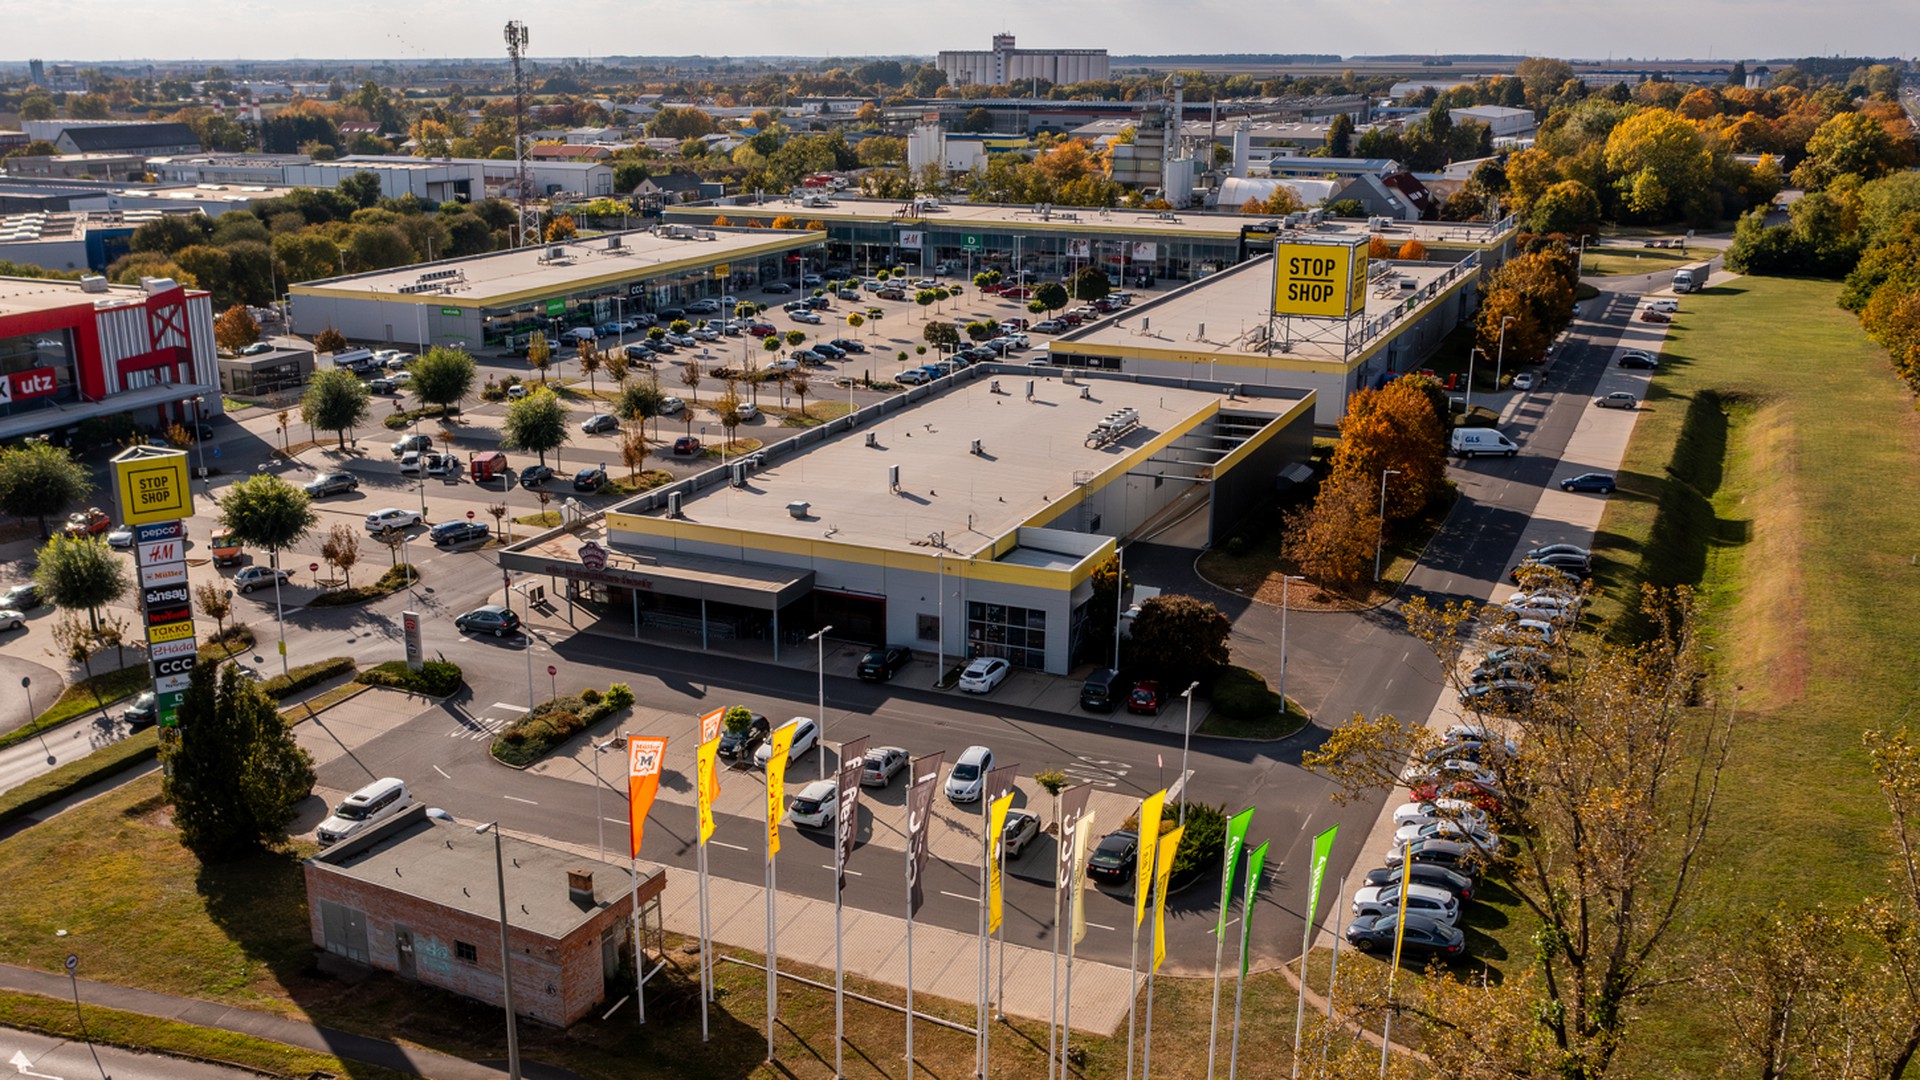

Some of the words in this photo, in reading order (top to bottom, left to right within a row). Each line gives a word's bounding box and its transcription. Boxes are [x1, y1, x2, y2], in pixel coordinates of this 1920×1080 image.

[1289, 257, 1336, 277] STOP
[631, 285, 643, 295] CCC
[1288, 283, 1334, 303] SHOP
[139, 476, 168, 490] STOP
[141, 490, 170, 504] SHOP
[141, 526, 176, 539] pepco
[149, 544, 174, 562] H&M
[146, 588, 187, 603] sinsay
[160, 658, 193, 674] CCC
